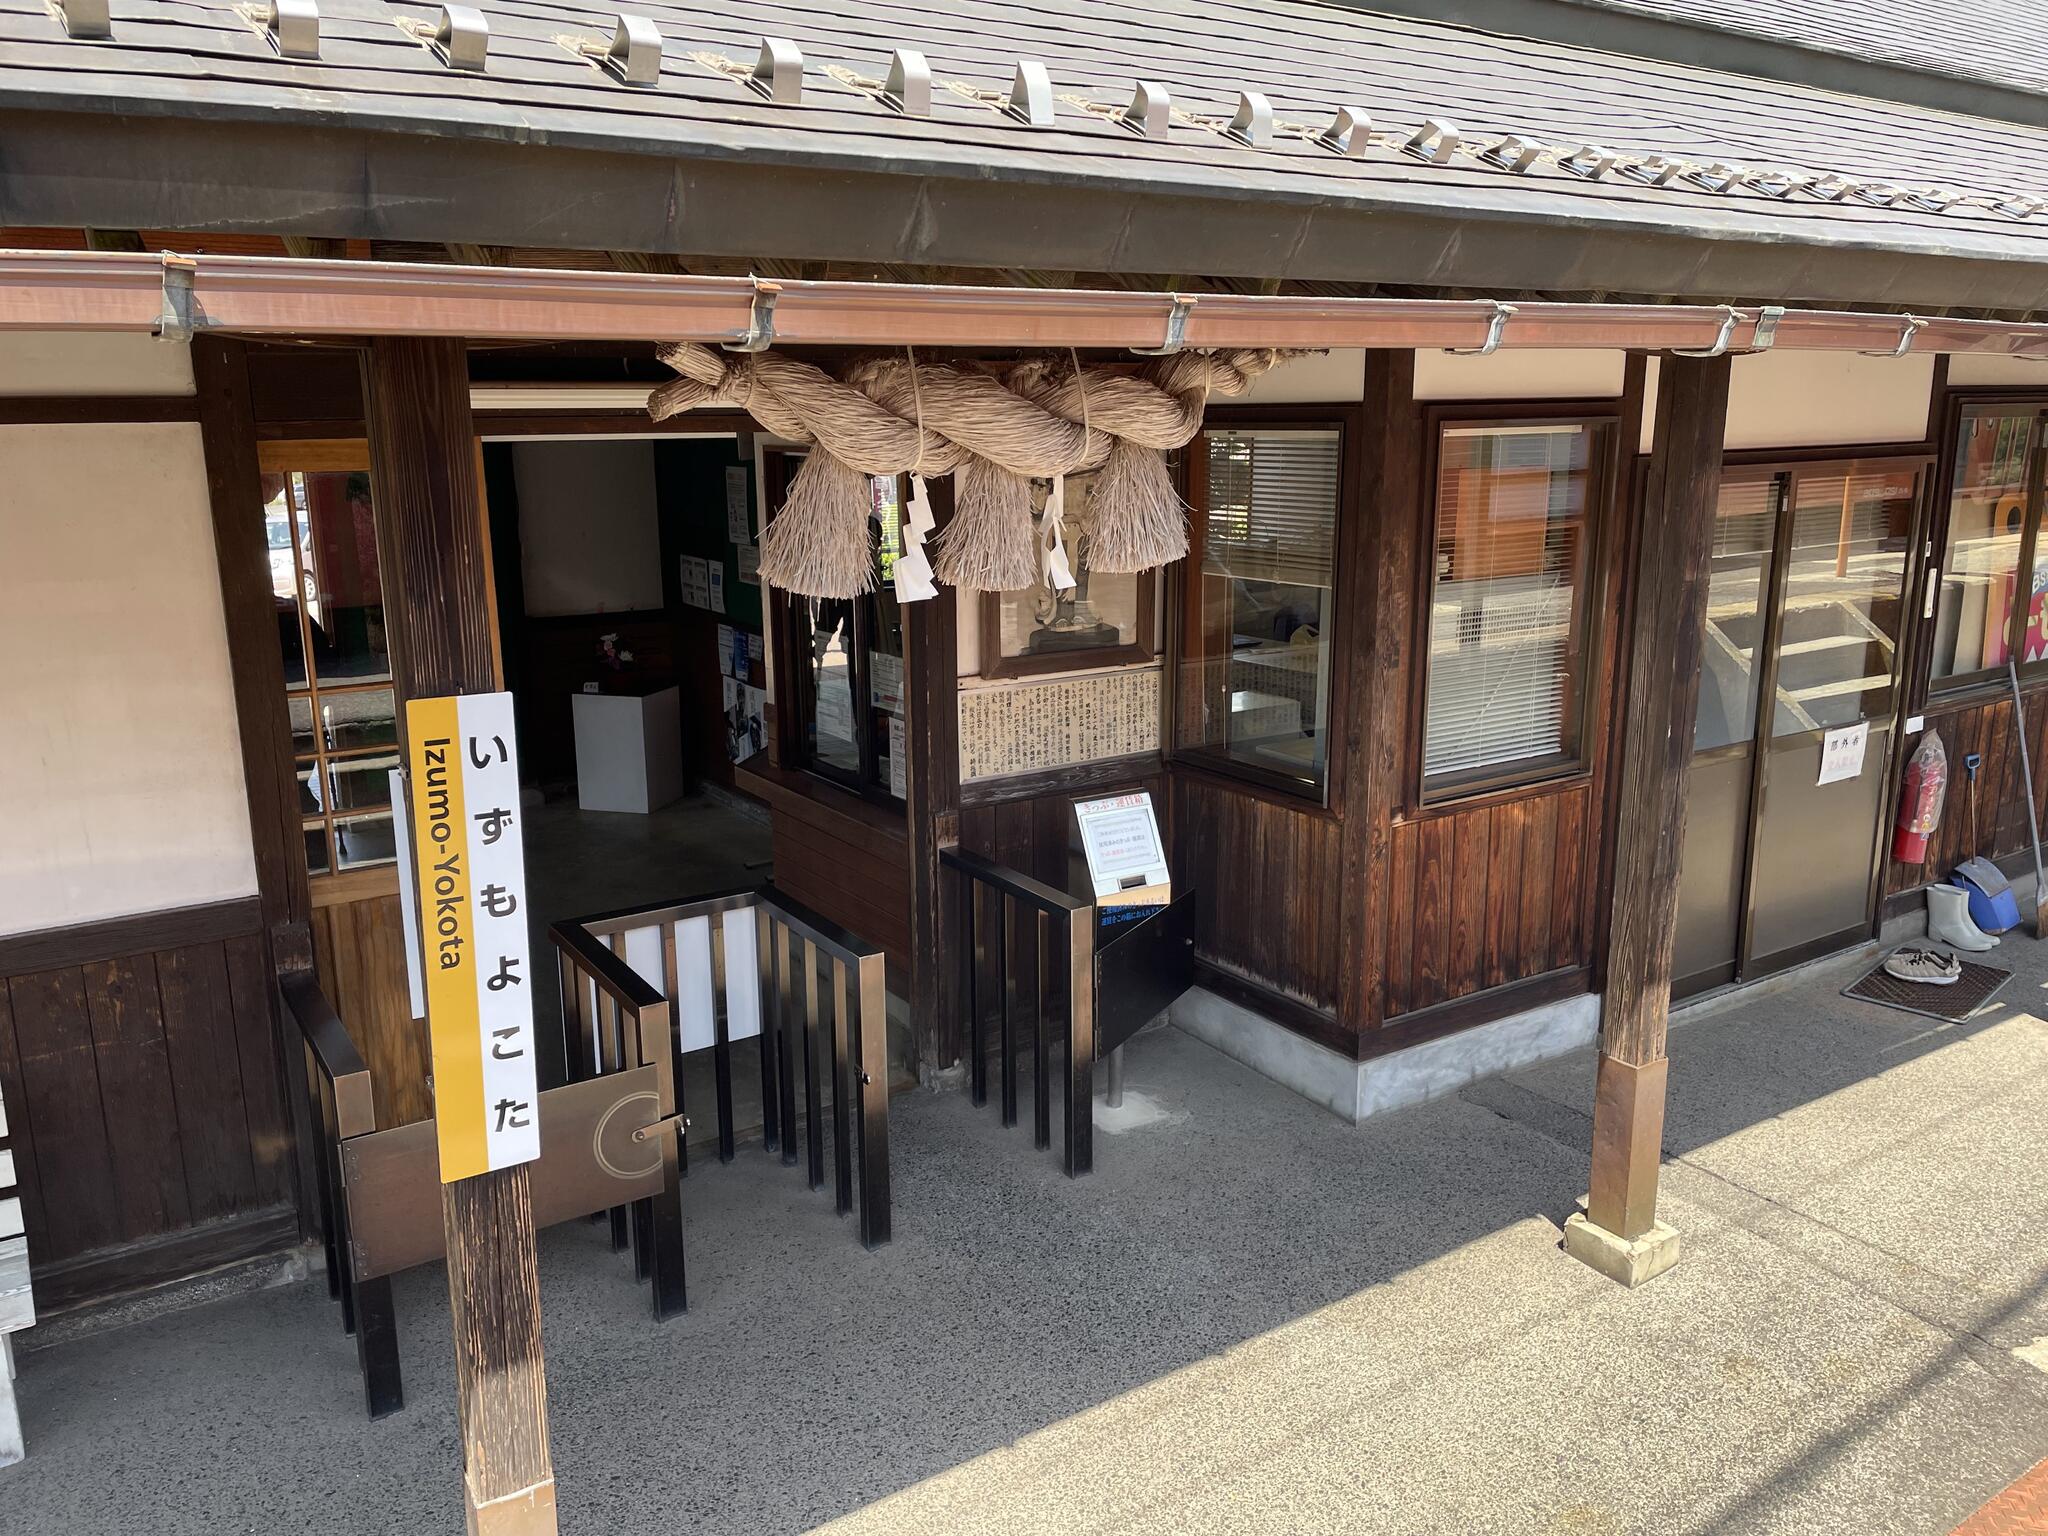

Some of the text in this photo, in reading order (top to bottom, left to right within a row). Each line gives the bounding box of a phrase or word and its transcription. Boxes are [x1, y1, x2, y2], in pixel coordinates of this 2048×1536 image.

[423, 738, 463, 970] Izumo-Yokota
[469, 734, 530, 1133] いずもよこた
